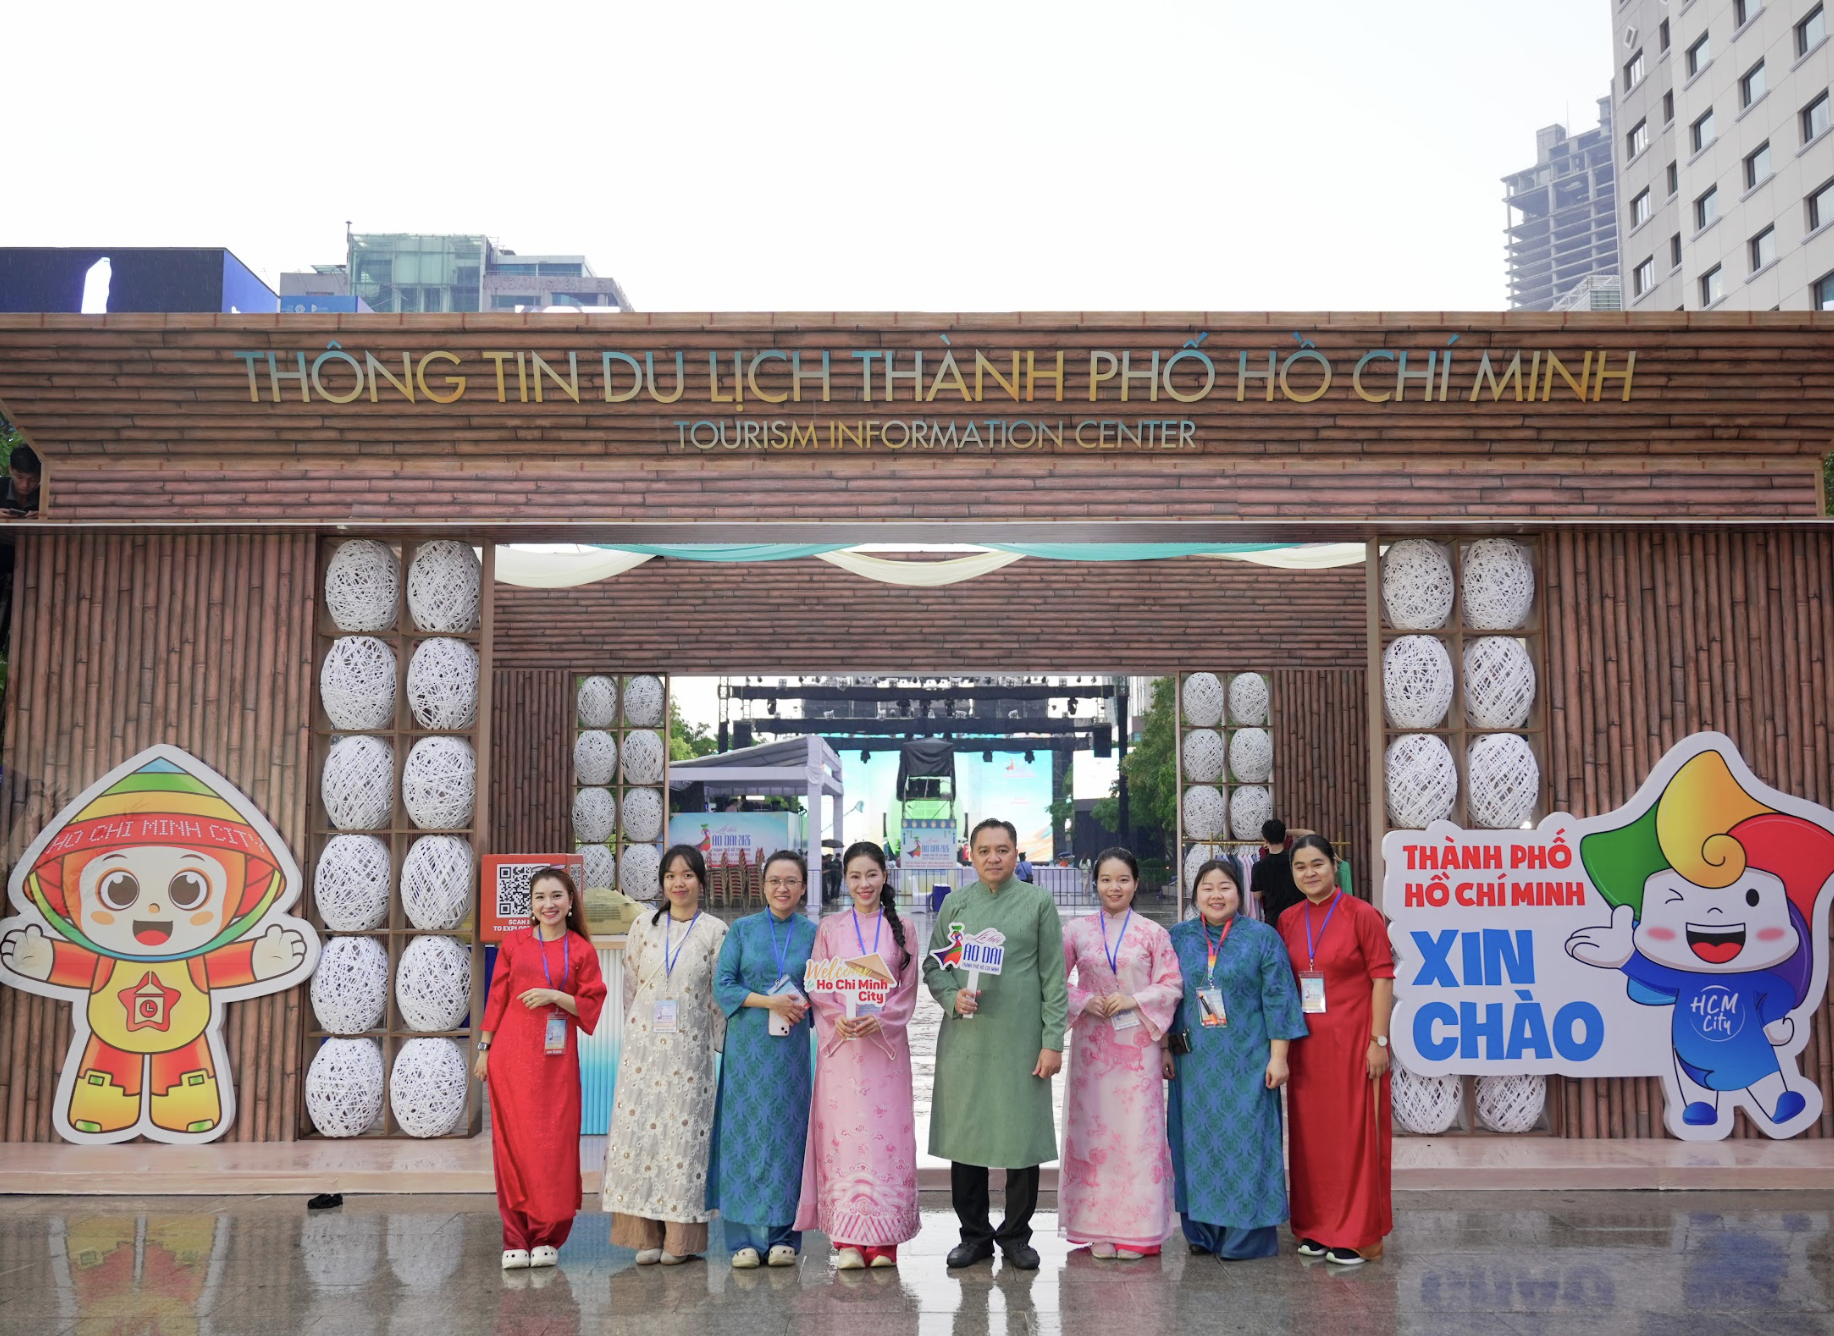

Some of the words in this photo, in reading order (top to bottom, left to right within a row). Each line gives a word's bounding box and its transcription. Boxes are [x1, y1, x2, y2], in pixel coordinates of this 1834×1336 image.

[234, 340, 466, 404] THÔNG
[483, 350, 580, 404] TIN
[602, 351, 685, 404] DU
[709, 350, 830, 412] LỊCH
[852, 333, 1064, 404] THÀNH
[1089, 331, 1216, 403] PHỐ
[1237, 331, 1332, 403] HỒ
[1352, 333, 1460, 403] CHÍ
[1470, 349, 1637, 403] MINH
[673, 420, 819, 450] TOURISM
[830, 419, 1064, 450] INFORMATION
[1075, 420, 1197, 449] CENTER
[46, 829, 84, 855] HO
[89, 820, 134, 842] CHI
[142, 819, 202, 838] MINH
[209, 824, 265, 853] CITY
[1403, 836, 1502, 870] THÀNH
[1510, 828, 1572, 870] PHỐ
[1404, 872, 1450, 907] HỒ
[1454, 873, 1507, 907] CHÍ
[1510, 882, 1586, 907] MINH
[806, 957, 873, 981] Welcome
[982, 946, 1002, 966] DÀI
[1410, 928, 1536, 988] XIN
[807, 980, 815, 989] to
[817, 979, 834, 990] Ho
[835, 979, 855, 990] Chi
[858, 979, 888, 990] Minh
[858, 991, 884, 1005] City
[1690, 993, 1739, 1015] HCM
[1412, 989, 1605, 1062] CHÀO
[1703, 1012, 1731, 1036] City
